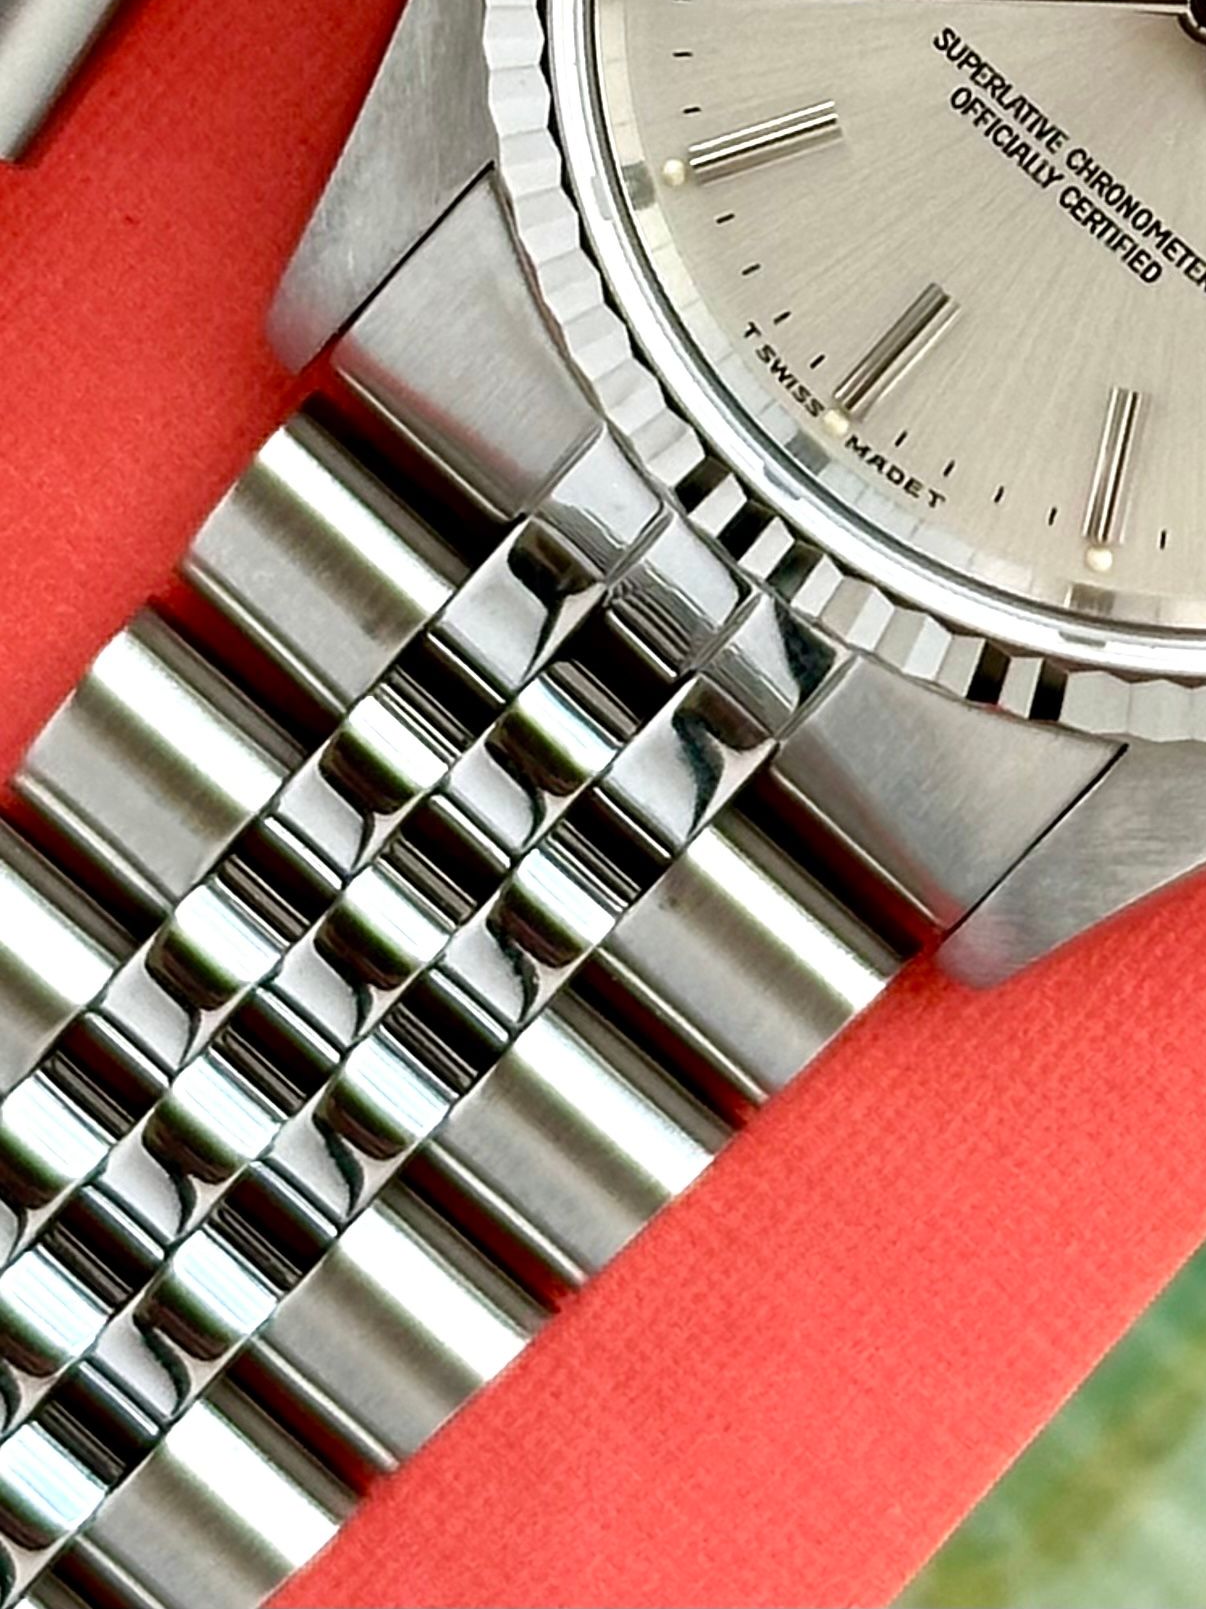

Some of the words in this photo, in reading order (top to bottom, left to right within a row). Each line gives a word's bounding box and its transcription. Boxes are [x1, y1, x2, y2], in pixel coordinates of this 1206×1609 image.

[933, 27, 1070, 155] SUPERLATIVE
[950, 86, 1064, 189] OFFICIALLY
[1058, 185, 1163, 285] CERTIFIED
[755, 343, 825, 418] SWISS
